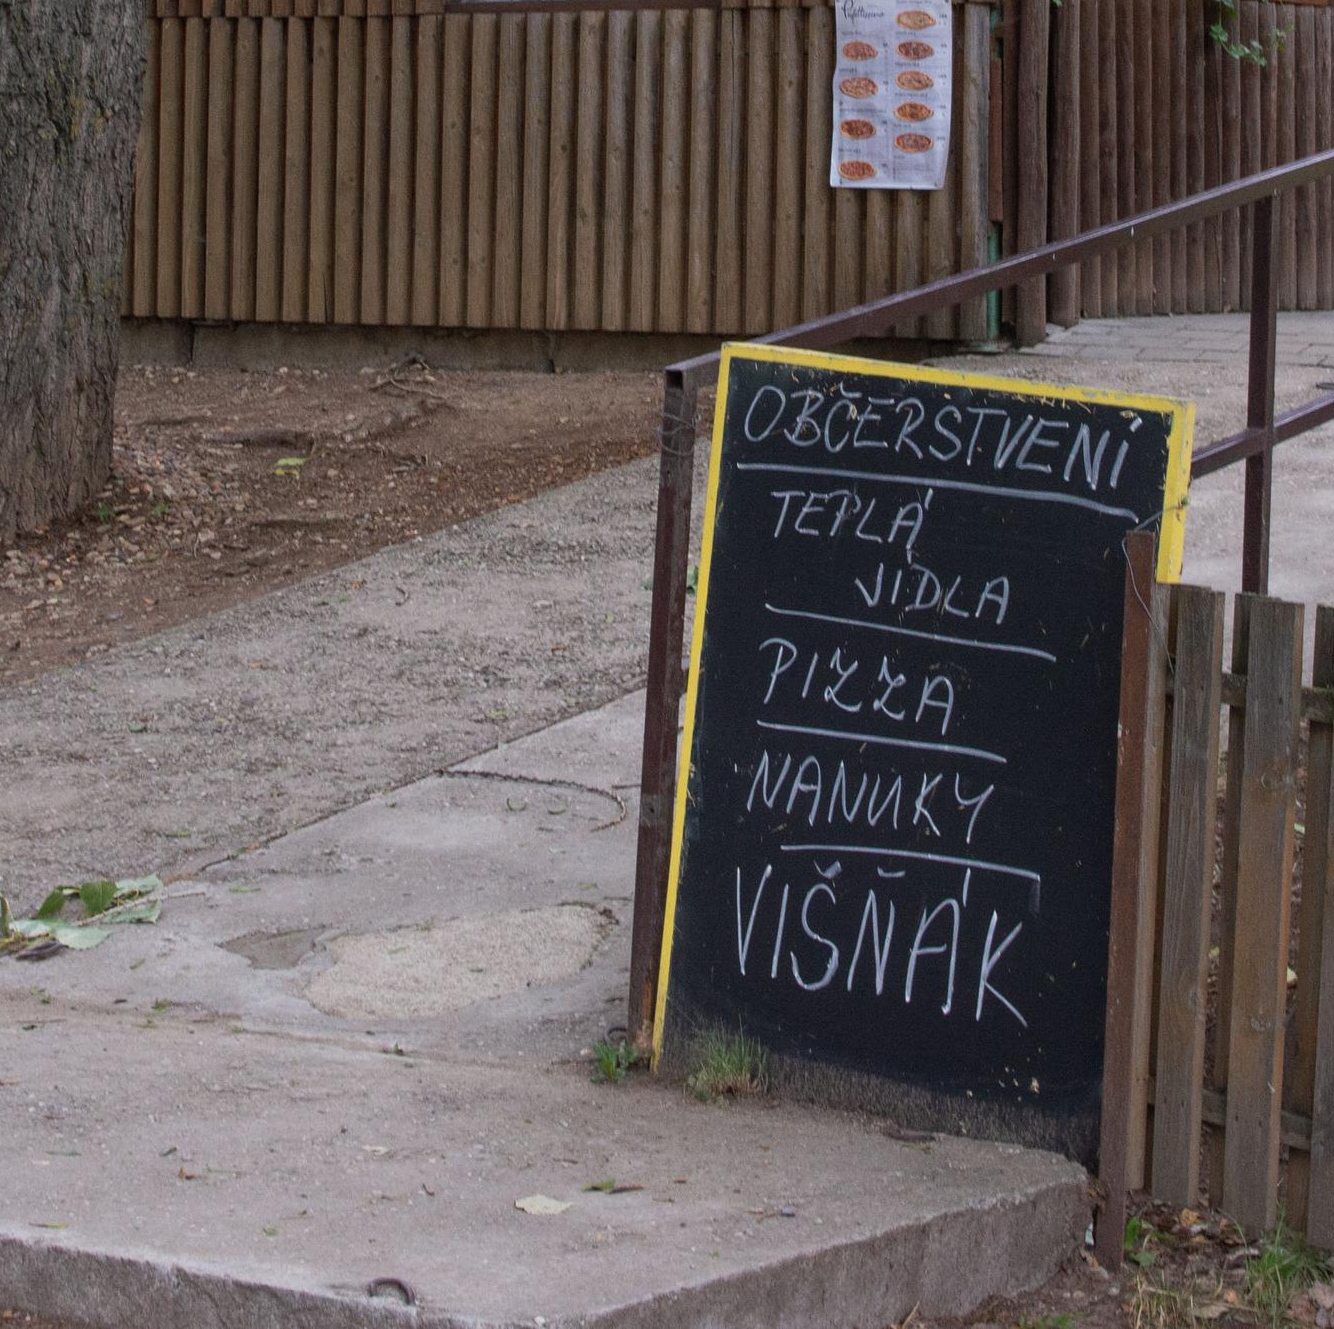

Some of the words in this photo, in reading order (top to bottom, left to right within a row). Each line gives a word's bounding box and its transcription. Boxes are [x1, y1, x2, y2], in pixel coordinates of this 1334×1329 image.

[744, 381, 1143, 490] OBČERSTVENÍ
[770, 487, 934, 550] TEPLÁ
[759, 637, 954, 736] PIZZA
[746, 749, 994, 844] NANUKY
[737, 860, 1028, 1028] VIŠŇÁK
